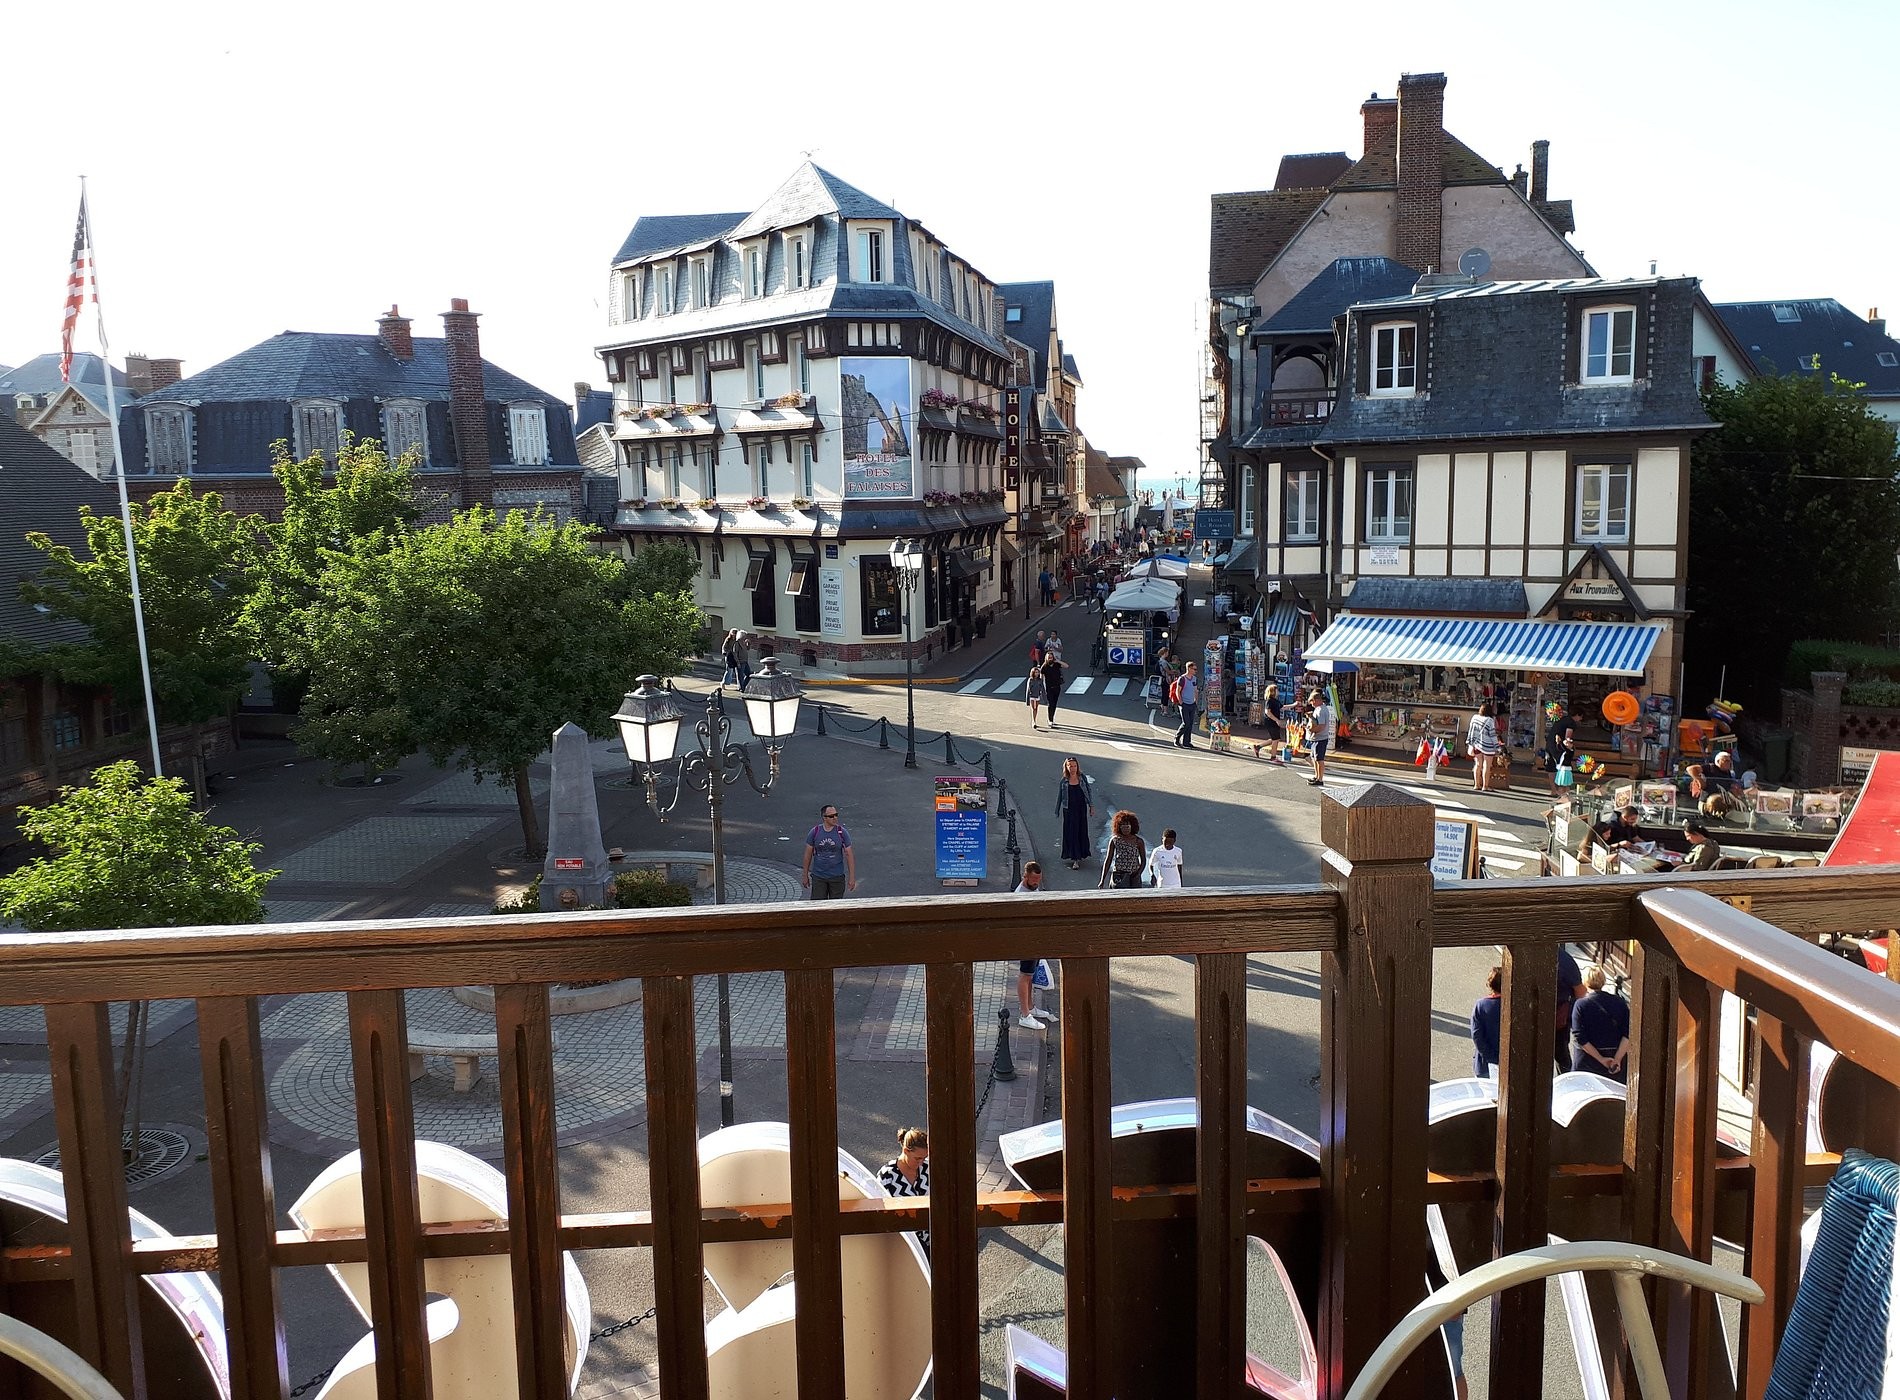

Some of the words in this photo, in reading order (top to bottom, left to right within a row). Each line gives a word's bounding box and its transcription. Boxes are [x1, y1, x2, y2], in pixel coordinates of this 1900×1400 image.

[1008, 393, 1018, 487] HOTEL
[866, 468, 890, 477] DES
[848, 482, 909, 491] FALAISES
[1570, 583, 1583, 594] Aux
[1585, 583, 1620, 595] Trouvailles
[1433, 865, 1457, 874] Salade
